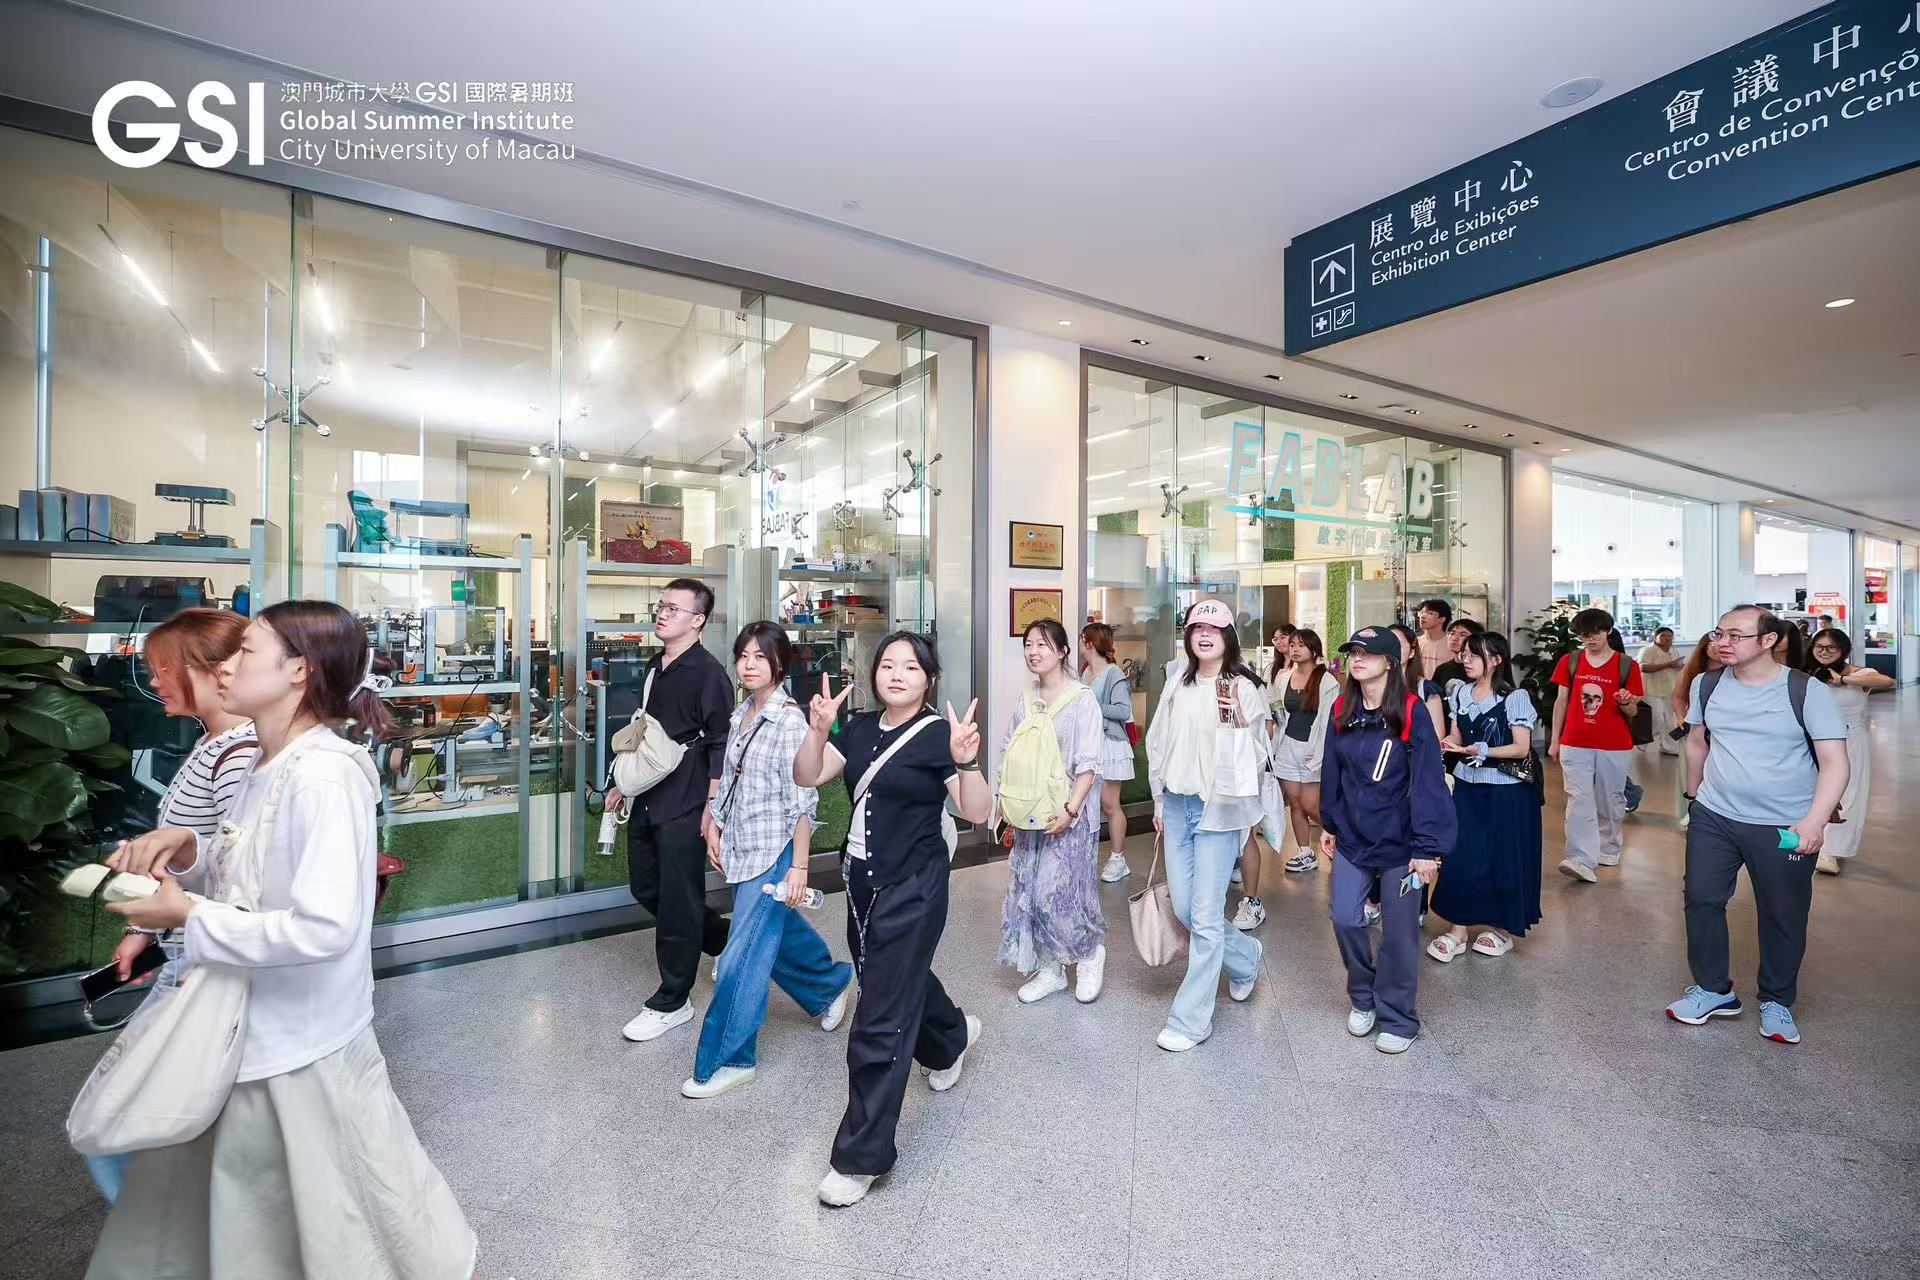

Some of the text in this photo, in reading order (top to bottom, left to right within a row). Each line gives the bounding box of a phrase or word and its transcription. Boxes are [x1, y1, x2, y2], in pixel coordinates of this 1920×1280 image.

[1624, 132, 1710, 171] Centro
[1718, 115, 1751, 137] de
[1667, 115, 1829, 180] Convention
[1369, 160, 1534, 250] 展覽中心
[1371, 195, 1540, 266] Centro de Exibições
[1371, 225, 1517, 286] Exhibition Center
[1225, 421, 1435, 520] FABLAB
